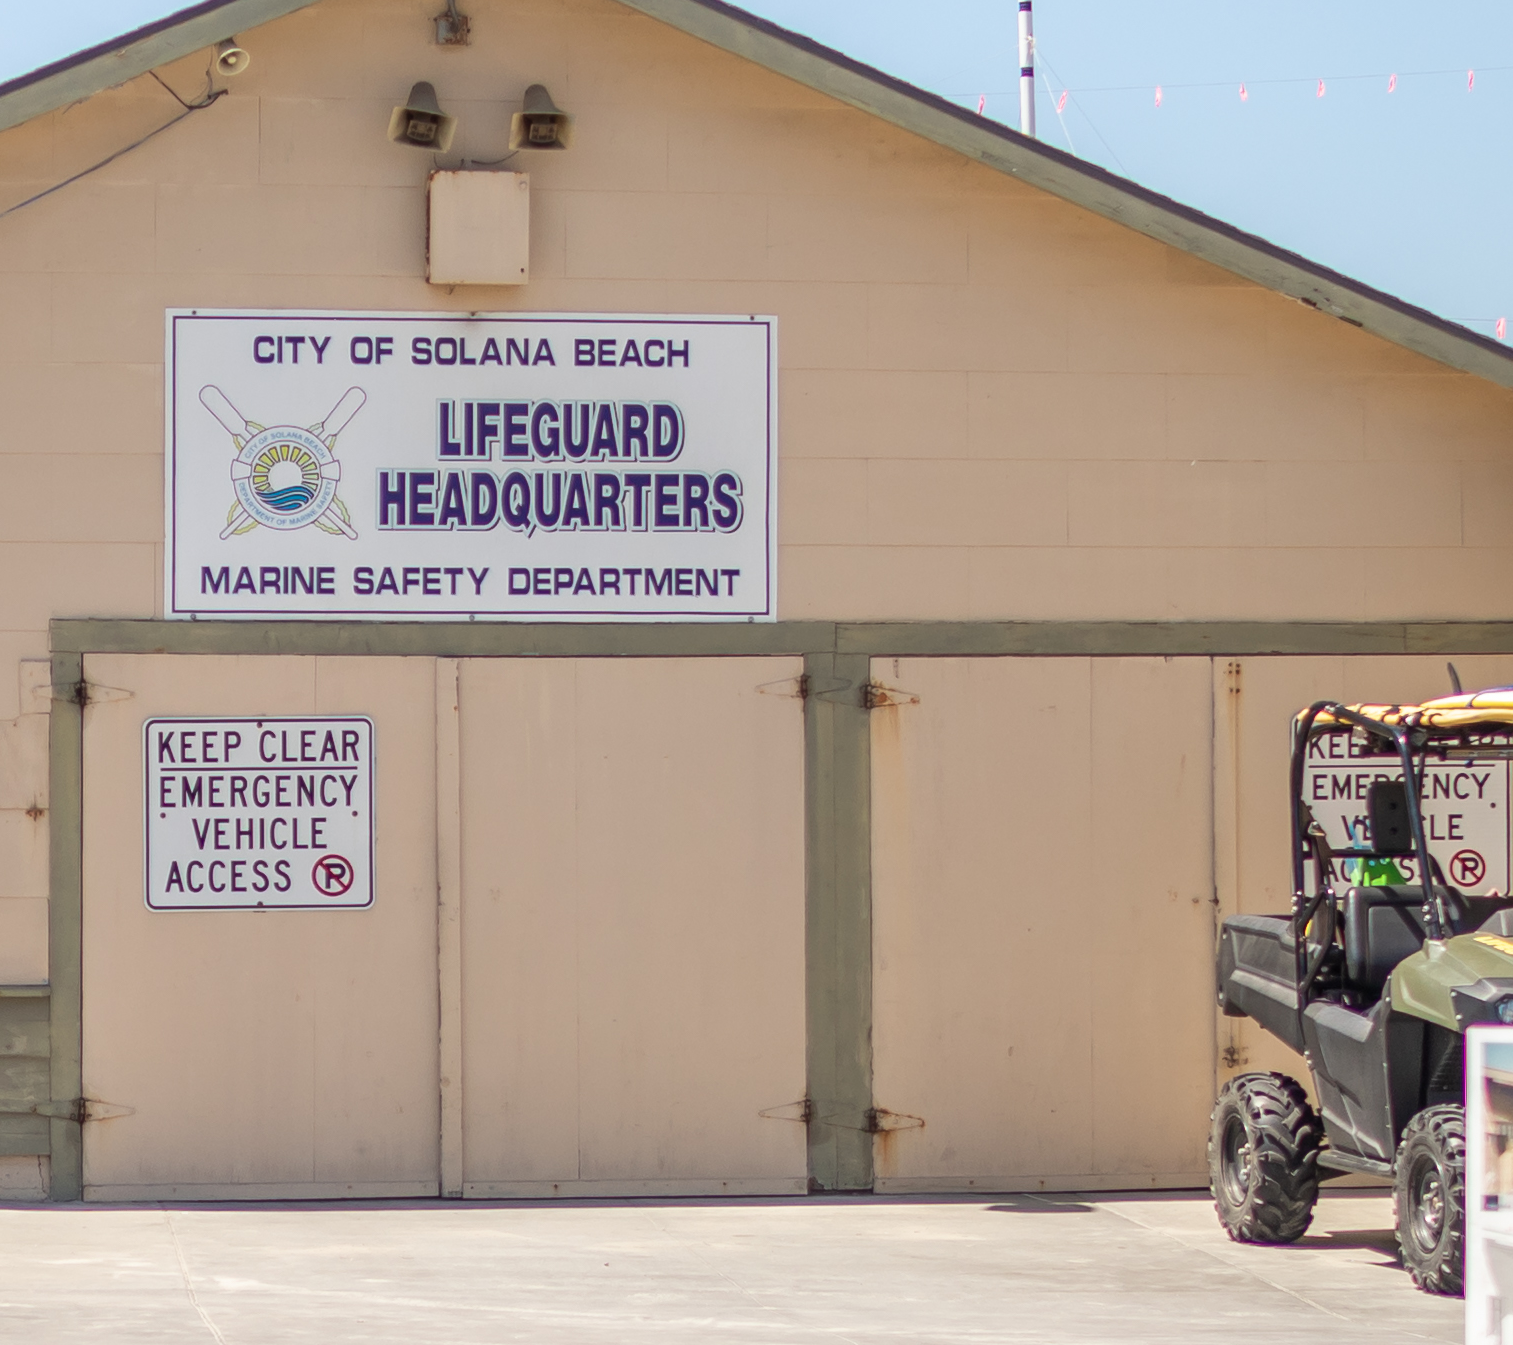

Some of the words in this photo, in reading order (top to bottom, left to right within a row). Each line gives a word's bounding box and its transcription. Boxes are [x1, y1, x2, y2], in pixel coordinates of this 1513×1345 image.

[253, 335, 332, 364] CITY
[350, 336, 394, 365] OF
[411, 337, 556, 367] SOLANA
[574, 339, 690, 368] BEACH
[244, 442, 259, 459] CITY
[270, 431, 303, 441] SOLANA
[303, 436, 327, 460] BEACH
[437, 400, 685, 463] LIFEGUARD
[377, 470, 743, 538] HEADQUARTERS
[201, 566, 336, 595] MARINE
[353, 566, 490, 596] SAFETY
[508, 567, 741, 597] DEPARTMENT
[158, 730, 242, 763] KEEP
[258, 730, 360, 762] CLEAR
[159, 774, 358, 808] EMERGENCY
[191, 817, 328, 850] VEHICLE
[165, 859, 292, 893] ACCESS
